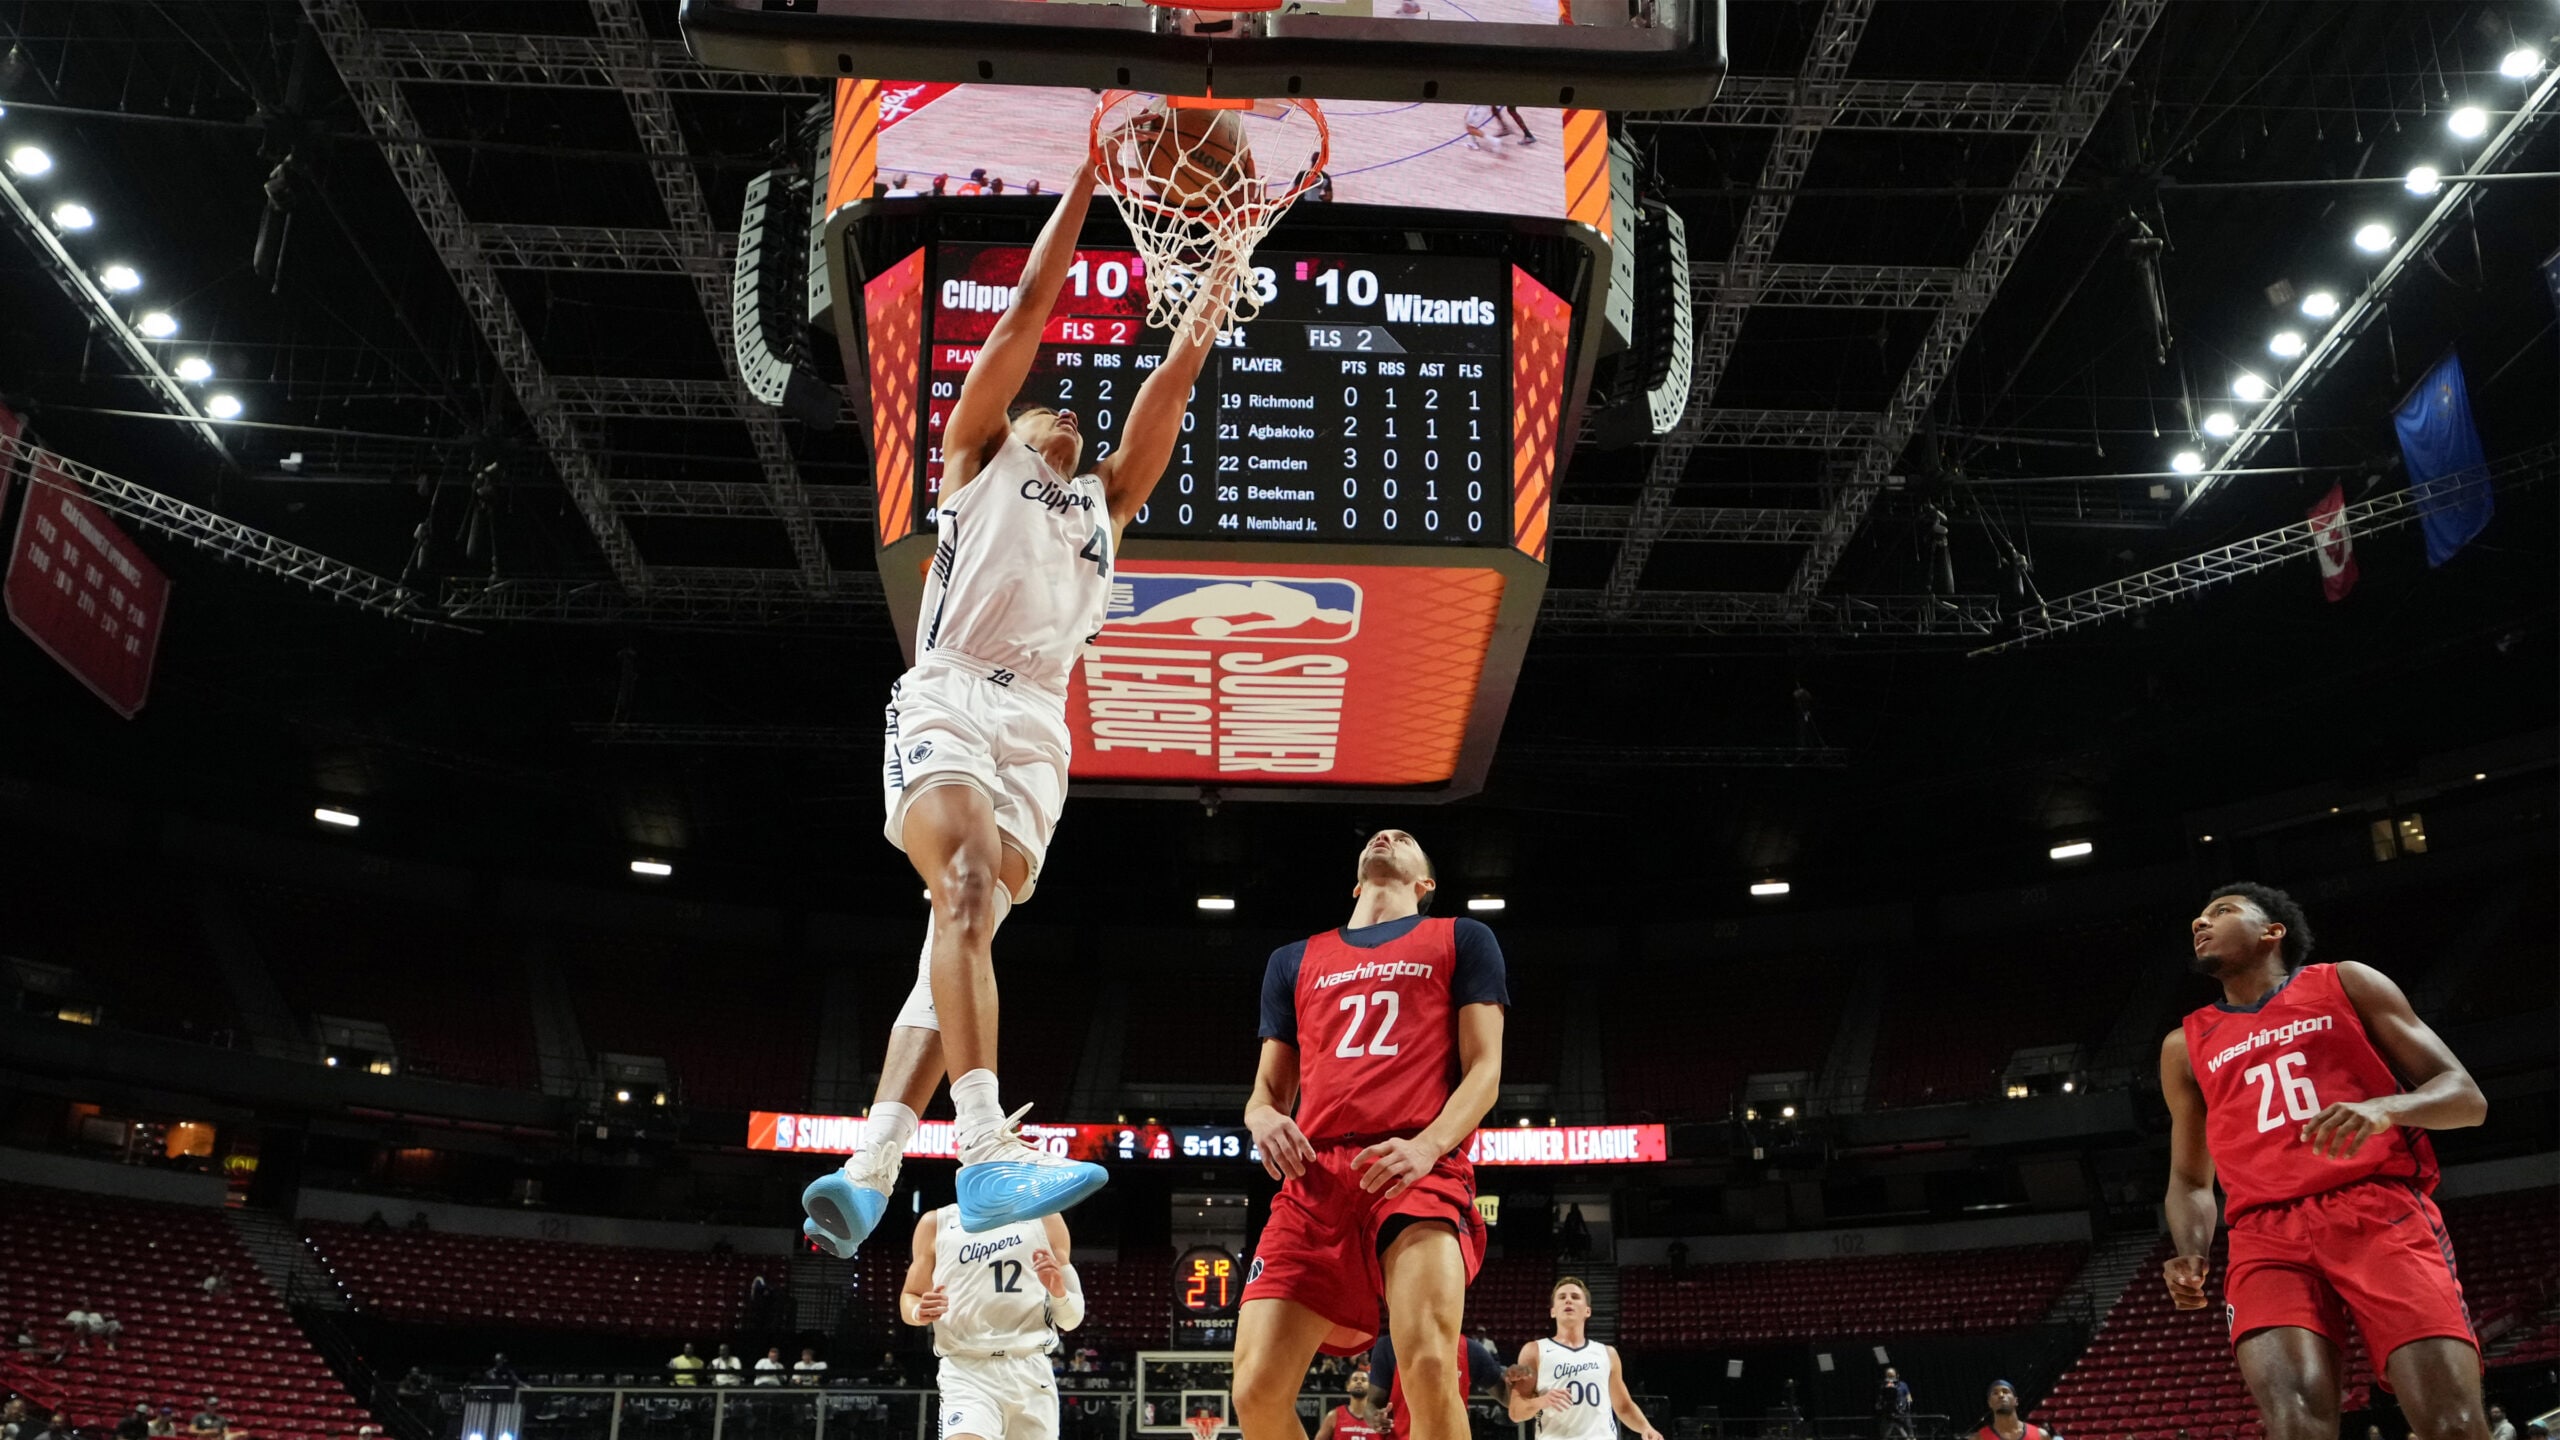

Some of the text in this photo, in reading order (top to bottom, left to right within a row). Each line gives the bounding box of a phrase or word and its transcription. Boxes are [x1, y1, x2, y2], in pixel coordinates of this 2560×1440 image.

[1067, 260, 1128, 298] 10
[1315, 268, 1379, 306] 10
[942, 279, 1018, 313] Clipp
[1384, 293, 1495, 326] Wizards
[1062, 322, 1126, 344] FLS 2
[1214, 326, 1247, 348] st
[1309, 329, 1373, 351] FLS 2
[946, 349, 1161, 369] PLAY PTS RBS AST
[1232, 357, 1483, 378] PLAYER PTS RBS AST FLS
[931, 381, 953, 398] 00
[1058, 378, 1073, 399] 2
[1098, 379, 1112, 400] 2
[1221, 386, 1481, 411] 19 Richmond 0 1 2 1
[929, 409, 1195, 433] 4 0 0
[1218, 416, 1481, 440] 21 Agbakoko 2 1 1 1
[1096, 440, 1110, 462] 2
[1181, 443, 1194, 464] 1
[1218, 447, 1482, 472] 22 Camden 3 0 0 0
[928, 473, 1194, 495] 1 0
[1217, 477, 1482, 502] 26 Beekman 0 0 1 0
[926, 503, 1193, 525] 4 0 0
[1217, 507, 1482, 532] 44 Nembhard Jr. 0 0 0 0
[1079, 524, 1109, 579] 4
[1108, 583, 1135, 612] NBA
[1083, 645, 1212, 757] LEAGUE
[1218, 652, 1349, 774] SUMMER
[1335, 990, 1400, 1059] 22
[2243, 1051, 2322, 1134] 26
[798, 1117, 956, 1155] SUMM AGUE
[1021, 1124, 1077, 1138] Clippers
[1118, 1129, 1169, 1149] 2 2
[1153, 1149, 1171, 1159] FLS
[1182, 1135, 1240, 1157] 5:13
[1482, 1128, 1639, 1162] SUMMER LEAGUE
[538, 1218, 571, 1238] 121
[959, 1234, 1023, 1265] Clippers
[1832, 1233, 1866, 1253] 102
[988, 1259, 1023, 1293] 12
[1194, 1259, 1230, 1277] 5:12
[1186, 1276, 1227, 1308] 21
[1194, 1319, 1235, 1328] TISSOT
[1553, 1361, 1600, 1380] Clippers
[1566, 1381, 1600, 1407] 00
